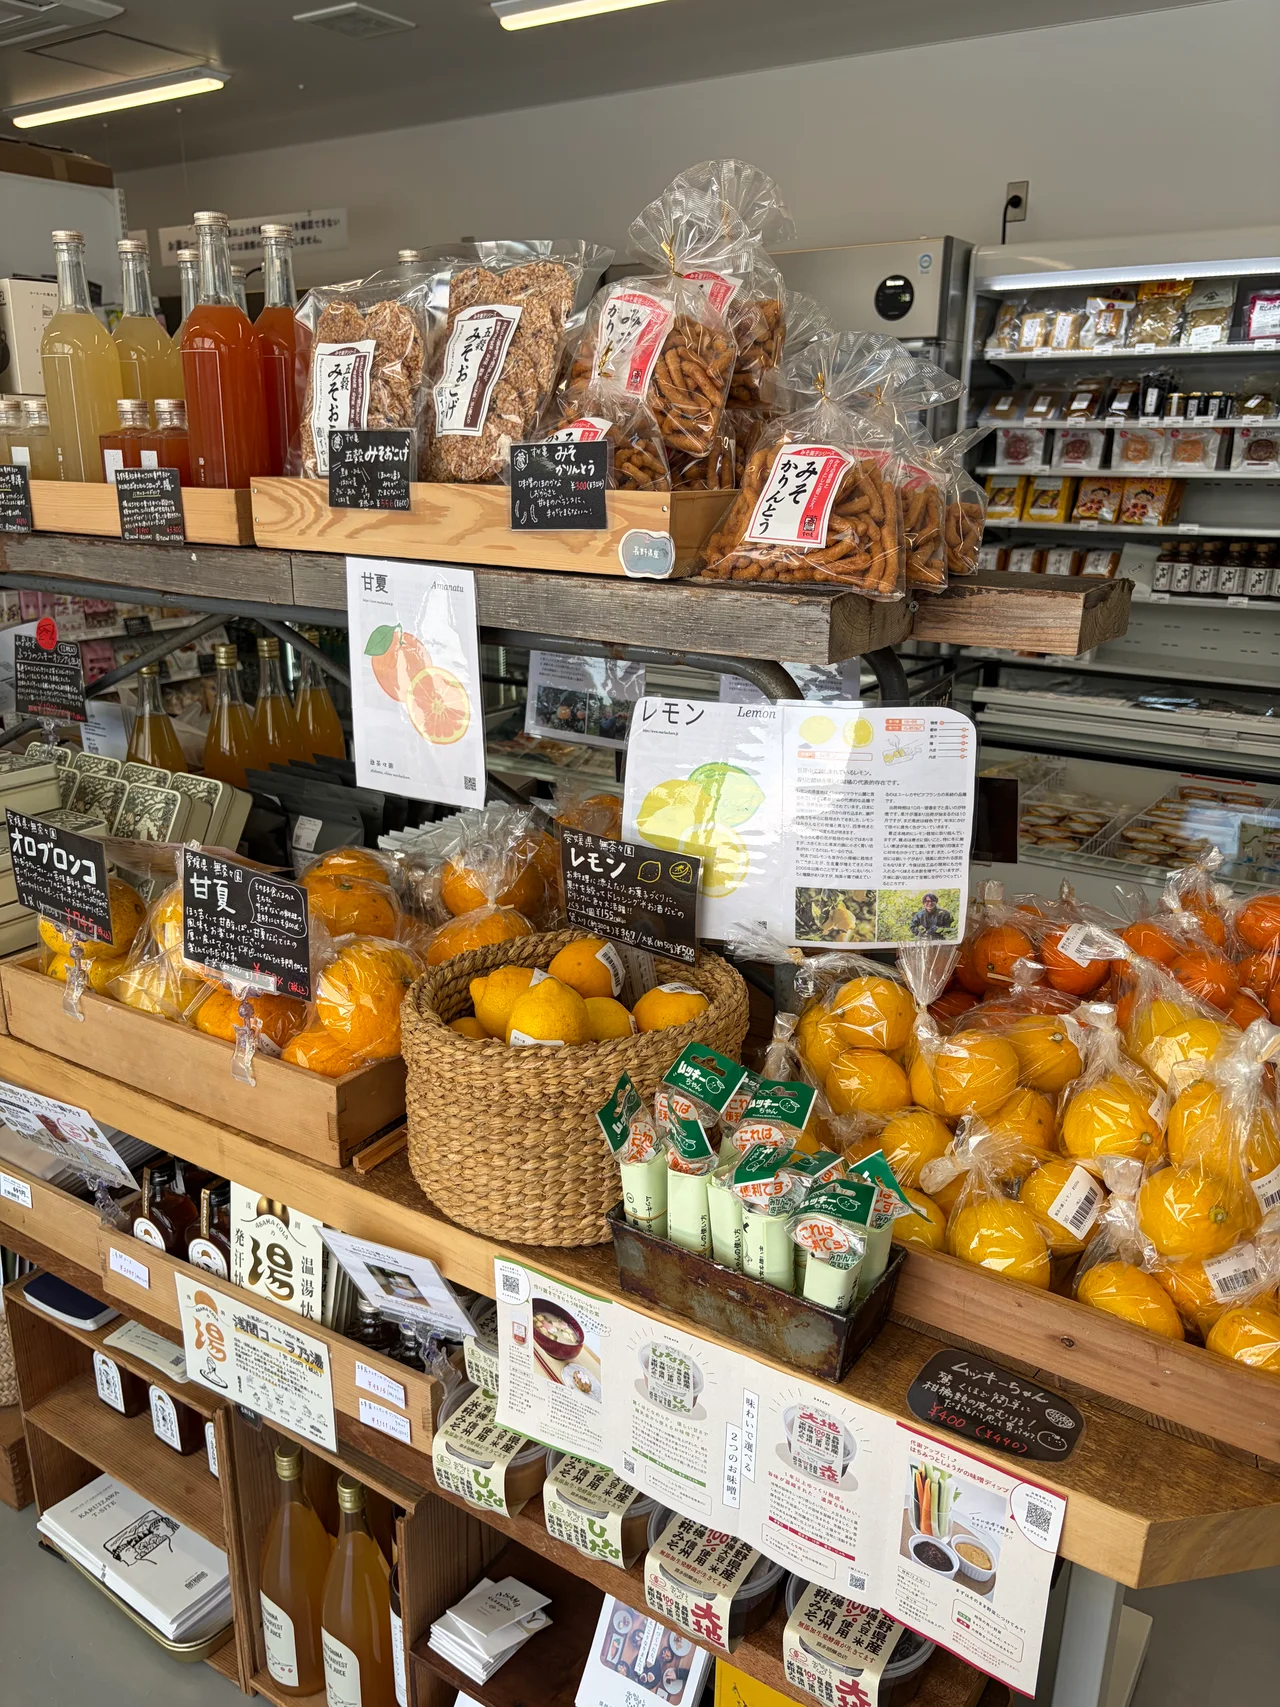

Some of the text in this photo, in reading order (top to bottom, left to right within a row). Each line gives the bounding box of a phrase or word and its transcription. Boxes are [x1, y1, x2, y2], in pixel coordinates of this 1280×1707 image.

[475, 327, 493, 351] 五穀
[341, 363, 352, 391] 五穀
[446, 328, 481, 420] みそおこげ
[555, 445, 576, 461] みそ
[555, 460, 595, 476] かりんとう
[788, 461, 818, 504] みそ
[759, 459, 799, 535] かりんとう
[361, 572, 388, 593] 甘夏
[431, 581, 464, 593] Amanatu
[643, 700, 704, 726] レモン
[737, 706, 776, 719] Lemon
[10, 828, 97, 885] オロブロンコ
[563, 831, 635, 858] 愛媛県 無茶々園
[571, 847, 626, 879] レモン
[190, 872, 236, 914] 甘夏
[677, 1060, 706, 1083] ムッキー
[685, 1078, 702, 1092] ちゃん
[748, 1099, 780, 1109] ムッキー
[740, 1127, 772, 1142] これは
[739, 1181, 784, 1198] 便利です
[799, 1196, 837, 1209] ムッキー
[815, 1203, 837, 1212] ちゃん
[255, 1220, 289, 1241] ASAMA COLA
[800, 1223, 834, 1240] これは
[247, 1235, 295, 1302] 湯
[193, 1316, 227, 1363] 湯
[232, 1314, 324, 1370] 浅間コーラ乃湯
[651, 1348, 691, 1371] ひなた
[951, 1362, 1048, 1404] ムッキーちゃん
[745, 1398, 755, 1474] 味わいで選べる
[797, 1411, 841, 1434] 大地
[928, 1402, 1028, 1452] ¥400 (¥440)
[726, 1432, 739, 1502] 2つのお味噌。
[819, 1464, 839, 1485] 大地
[910, 1447, 1010, 1494] はちみつとしょうがの味噌ディップ
[472, 1469, 504, 1507] ひなた
[613, 1484, 635, 1504] 県産
[78, 1490, 120, 1519] KARUIZAWA
[91, 1501, 117, 1518] T-SITE
[587, 1518, 620, 1559] ひなた
[720, 1542, 753, 1583] 長野県産
[805, 1588, 831, 1622] 糀みそ
[819, 1594, 845, 1631] 機・信州
[691, 1603, 725, 1648] 大地
